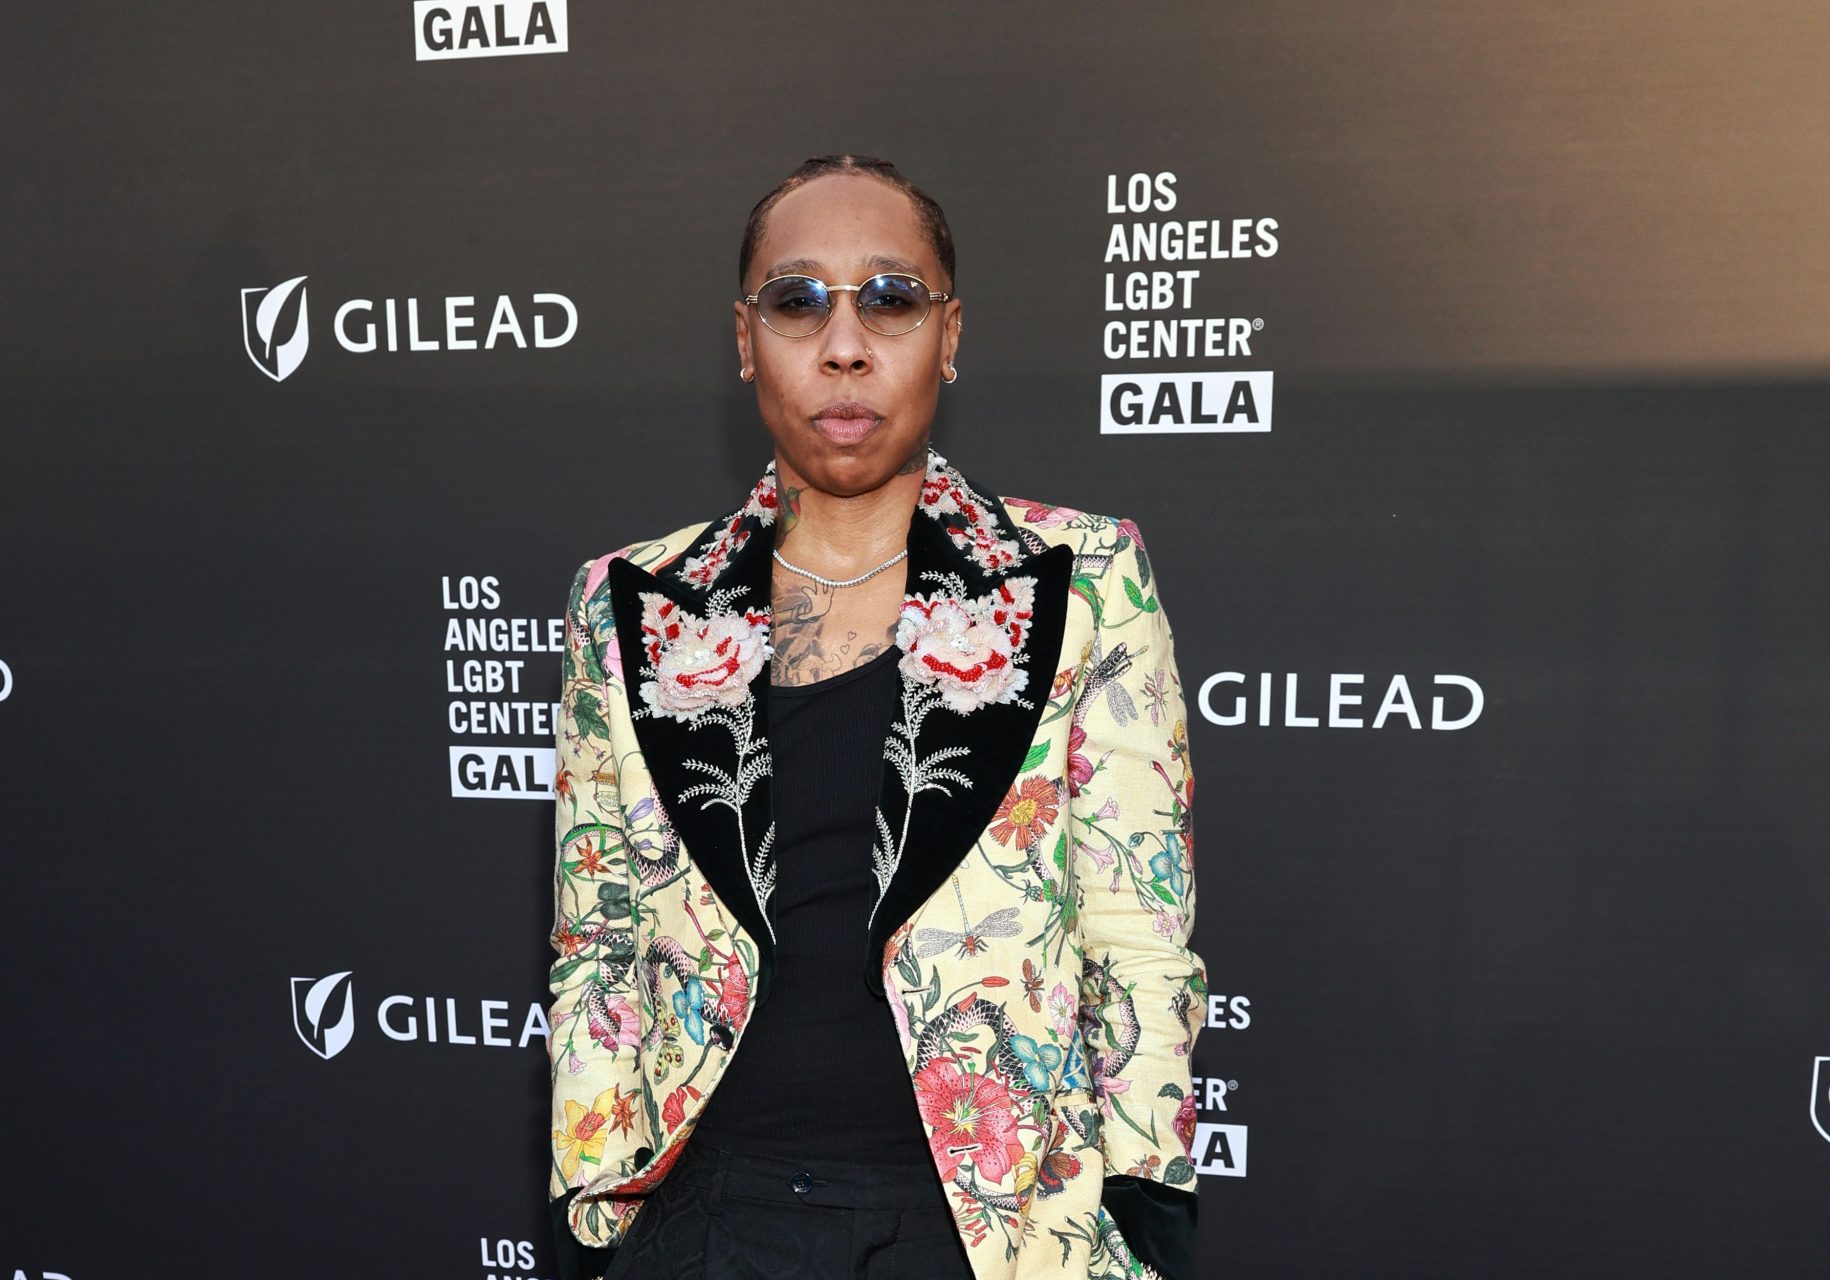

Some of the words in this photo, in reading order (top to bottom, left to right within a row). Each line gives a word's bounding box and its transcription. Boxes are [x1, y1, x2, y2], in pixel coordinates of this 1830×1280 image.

[423, 1, 557, 51] GALA
[1107, 171, 1178, 214] LOS
[1104, 217, 1279, 263] ANGELES
[1105, 270, 1200, 311] LGBT
[333, 293, 579, 354] GILEAD
[1109, 380, 1260, 426] GALA
[442, 576, 501, 610] LOS
[446, 660, 525, 693] LGBT
[1197, 671, 1485, 731] GILEAD
[458, 753, 556, 793] GAL
[1201, 994, 1252, 1030] ES
[480, 1237, 536, 1271] LOS
